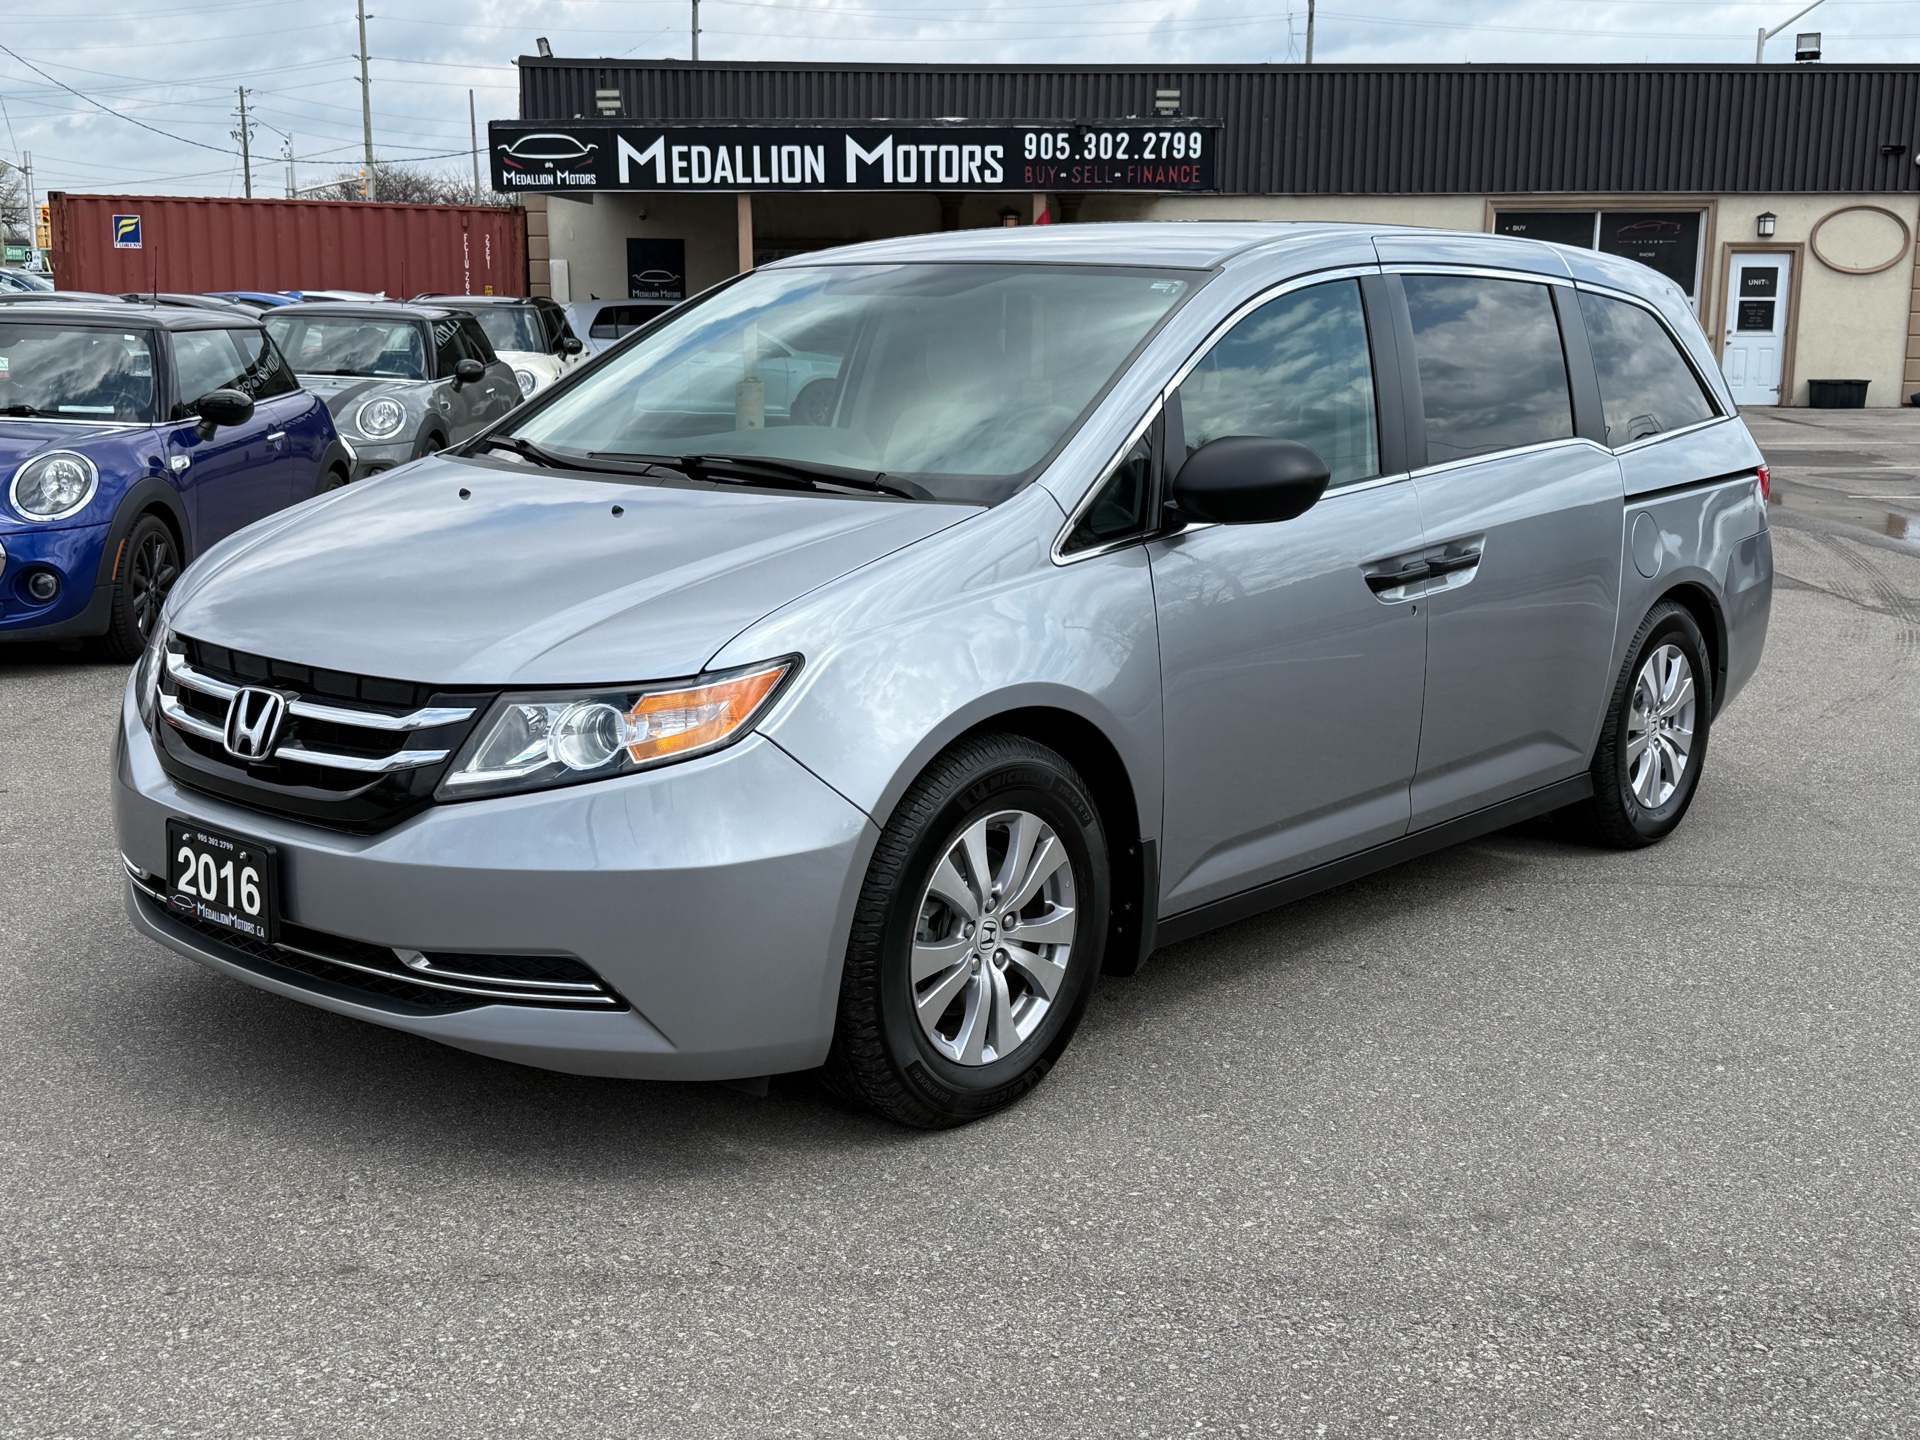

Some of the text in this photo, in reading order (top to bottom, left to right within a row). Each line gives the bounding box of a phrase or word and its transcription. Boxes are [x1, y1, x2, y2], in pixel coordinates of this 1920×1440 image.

[1024, 132, 1202, 160] 905.302.2799
[617, 134, 1004, 184] MEDALLION MOTORS
[503, 170, 596, 186] MEDALLION MOTORS
[1024, 165, 1201, 183] BUY SELL FINANCE
[632, 289, 682, 298] MEDALLION MOTORS
[197, 833, 208, 843] 905
[177, 846, 261, 916] 2016
